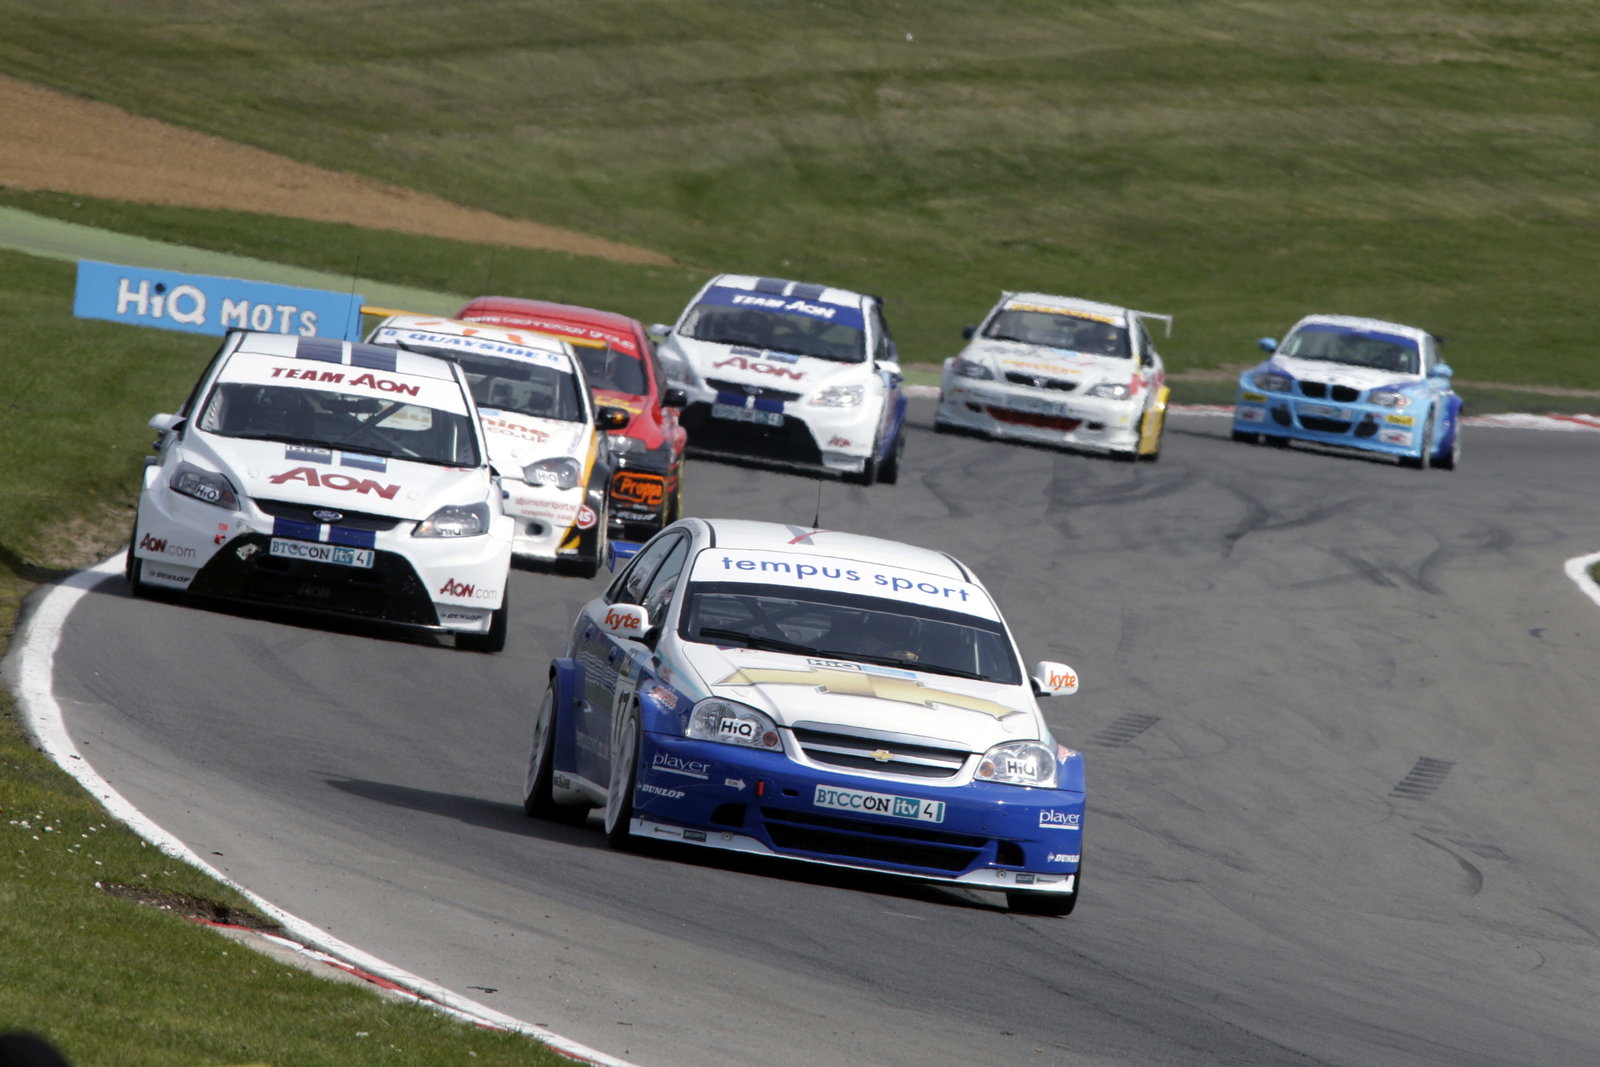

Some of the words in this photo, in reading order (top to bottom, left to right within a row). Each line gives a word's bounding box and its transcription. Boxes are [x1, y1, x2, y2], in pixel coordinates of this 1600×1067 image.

[116, 278, 207, 325] HiQ
[221, 298, 318, 337] MOTS
[408, 333, 539, 358] QUAYSIDE
[271, 367, 345, 384] TEAM
[356, 551, 365, 564] 4
[721, 556, 861, 582] tempus
[874, 574, 970, 602] sport
[605, 608, 641, 630] kyte
[1049, 673, 1077, 691] kyte
[721, 720, 752, 737] HiQ
[652, 753, 711, 773] player
[641, 783, 685, 799] DUNLOP
[894, 799, 919, 816] itv
[922, 803, 934, 819] 4
[1039, 809, 1081, 825] player
